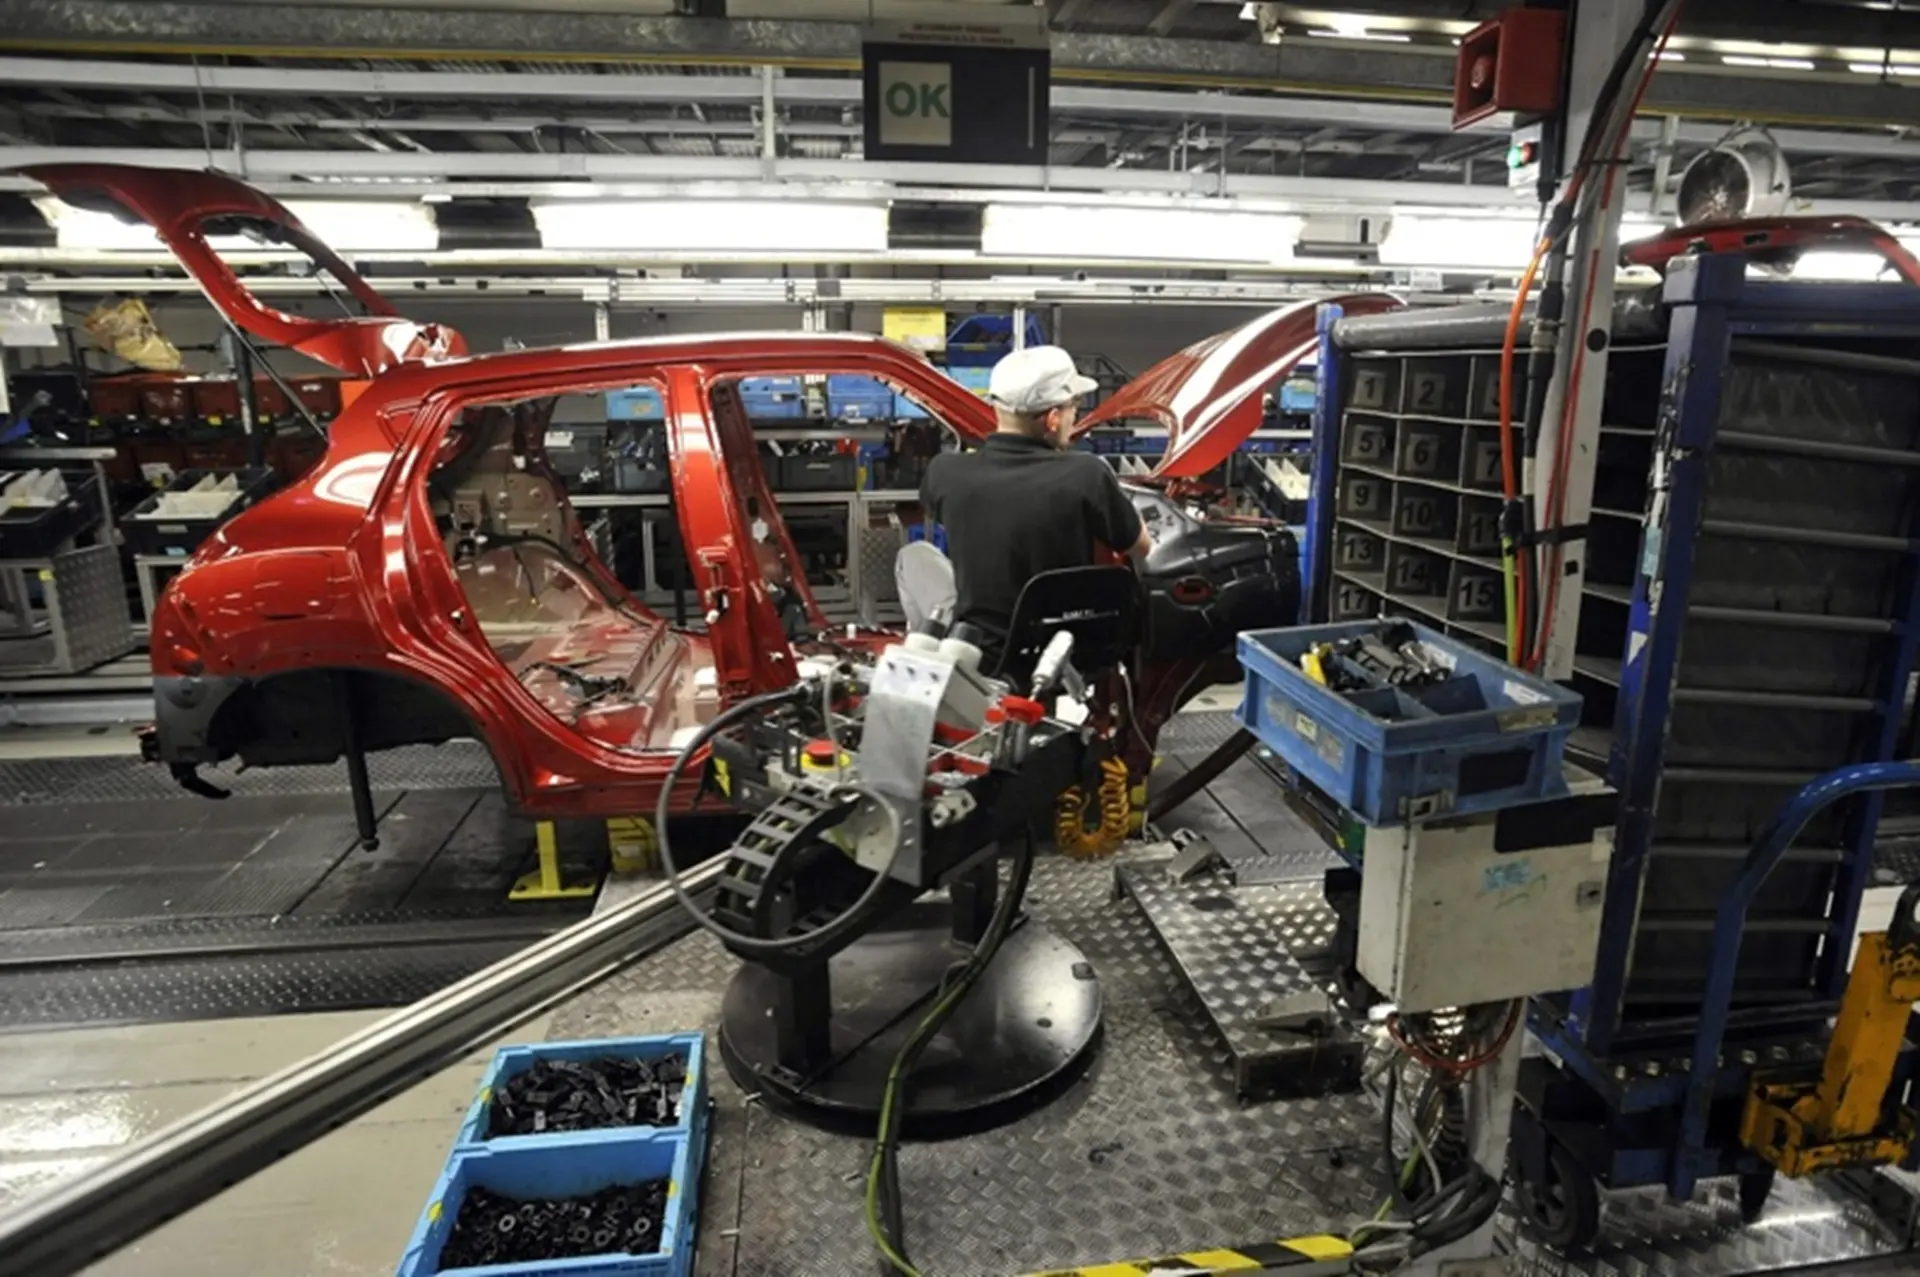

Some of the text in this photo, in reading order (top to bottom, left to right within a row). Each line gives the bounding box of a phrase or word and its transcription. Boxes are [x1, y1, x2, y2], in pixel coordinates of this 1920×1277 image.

[885, 81, 950, 118] OK
[1365, 377, 1376, 400] 1
[1418, 381, 1435, 406] 2
[1359, 431, 1375, 453] 5
[1413, 440, 1429, 466] 6
[1355, 485, 1370, 507] 9
[1404, 501, 1433, 527] 10
[1345, 538, 1372, 560] 13
[1396, 558, 1430, 584] 14
[1340, 588, 1367, 611] 17
[1461, 580, 1494, 608] 15
